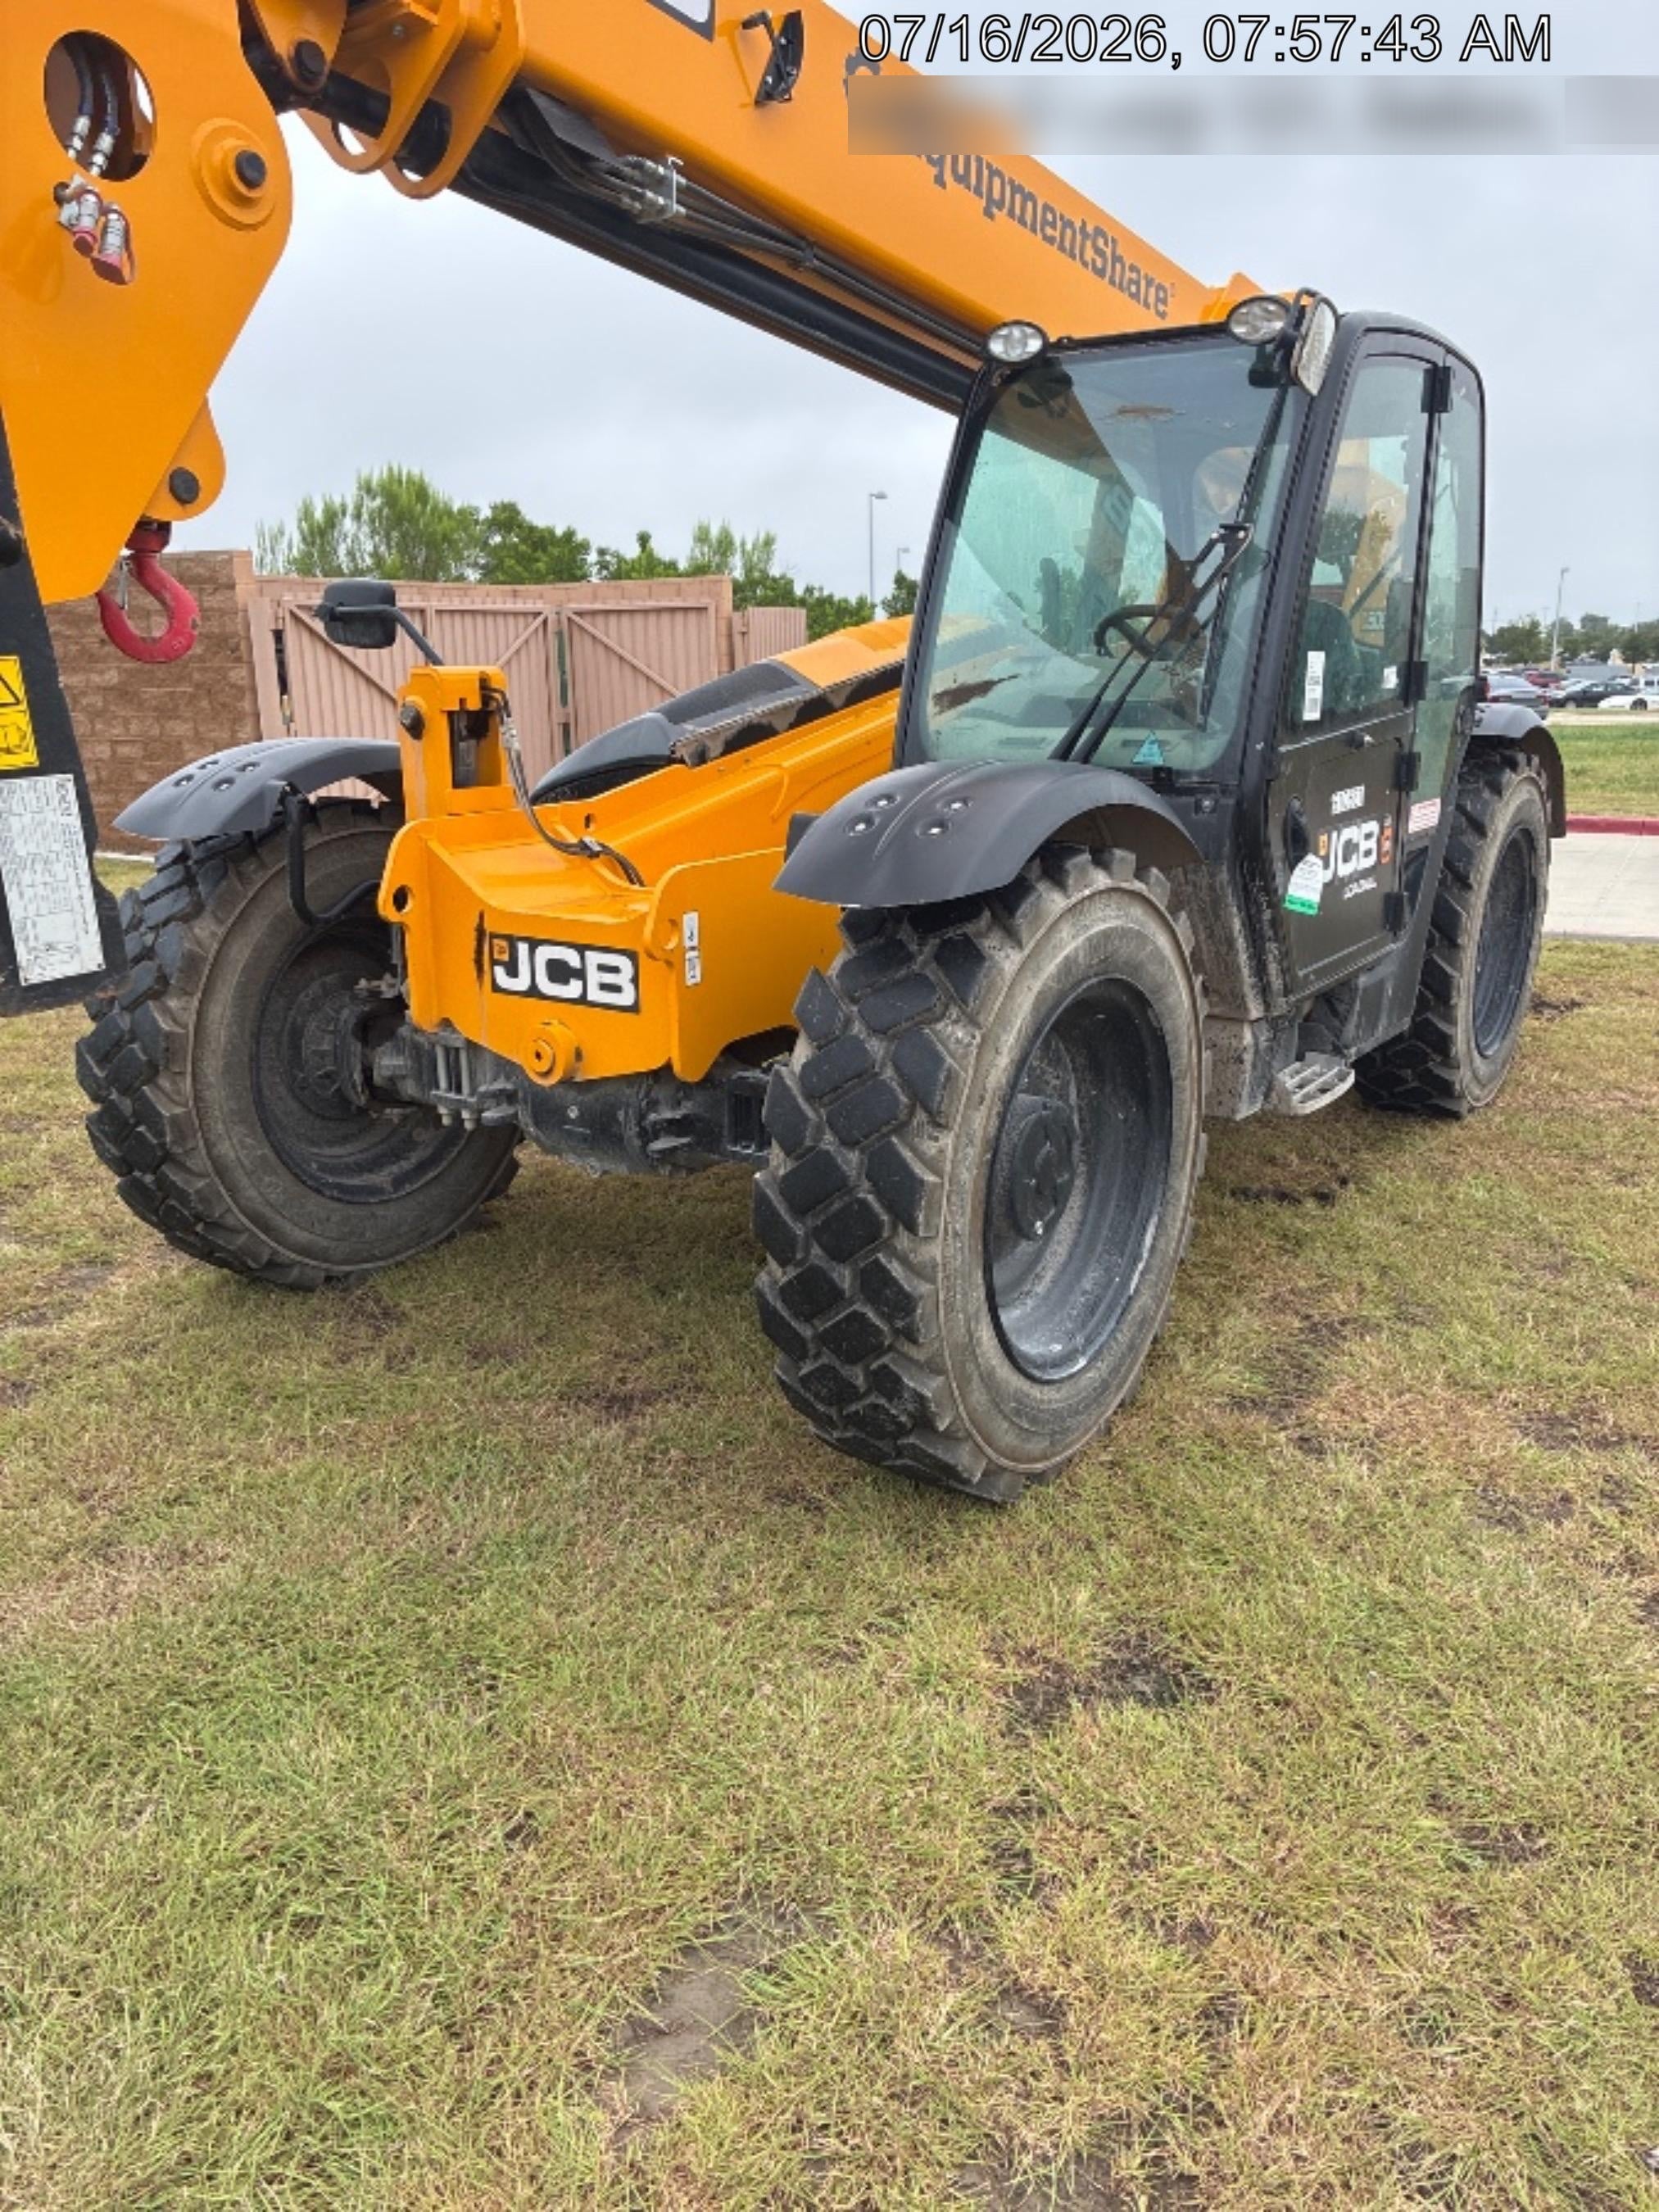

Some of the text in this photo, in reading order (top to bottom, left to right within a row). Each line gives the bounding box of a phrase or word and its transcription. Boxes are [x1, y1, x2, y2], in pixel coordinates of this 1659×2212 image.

[916, 153, 1169, 320] quipmentShare
[1321, 820, 1380, 883] JCB
[493, 941, 637, 1007] JCB
